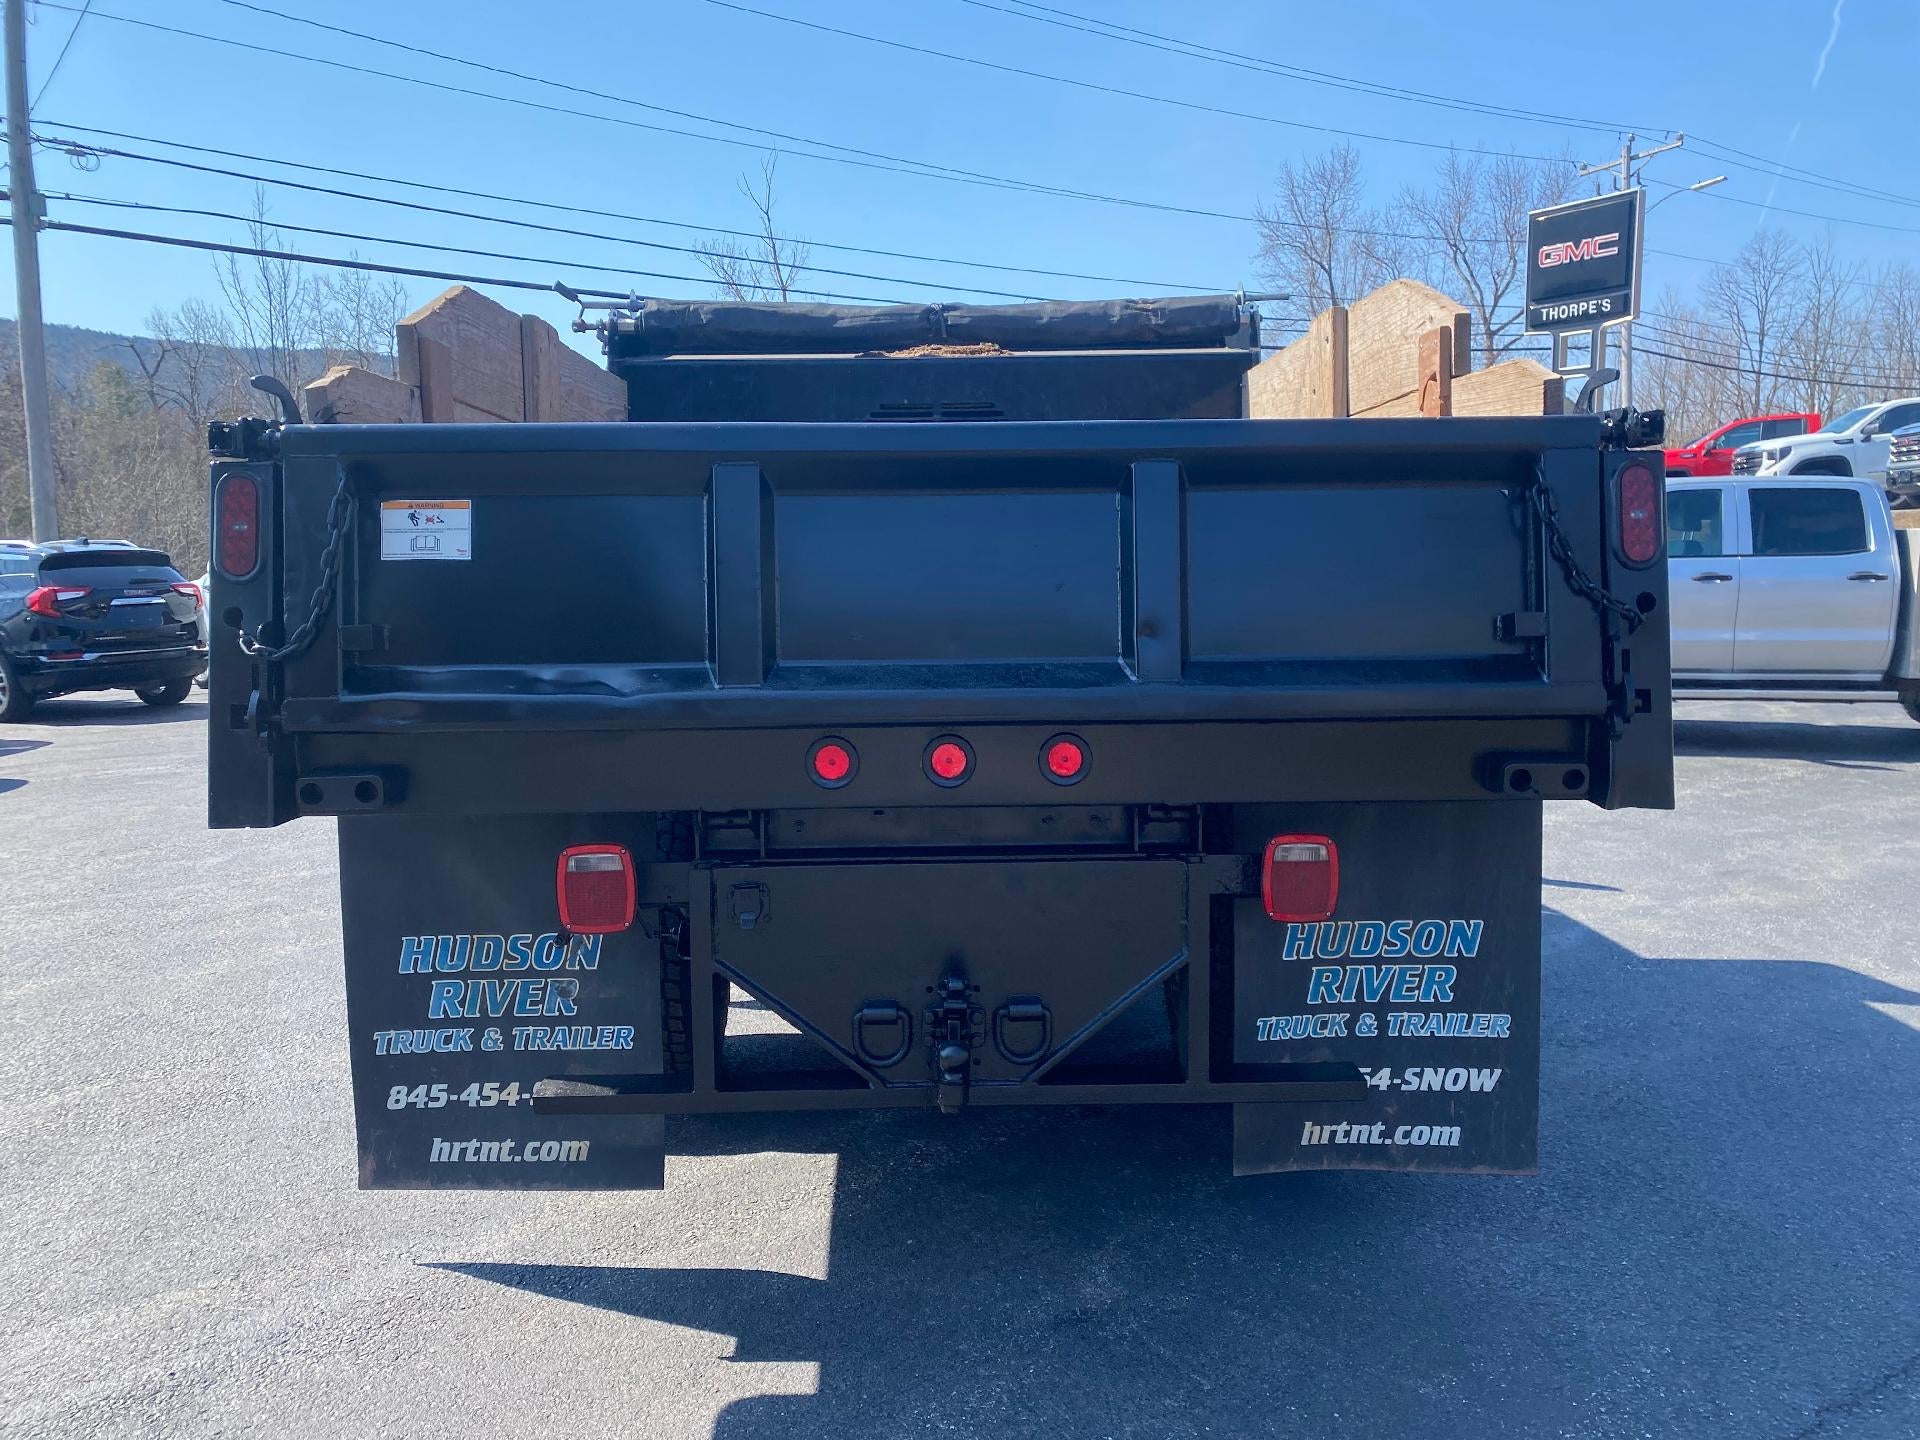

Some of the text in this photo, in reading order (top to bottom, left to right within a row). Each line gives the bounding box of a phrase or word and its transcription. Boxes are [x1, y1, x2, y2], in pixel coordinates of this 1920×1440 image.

[1539, 233, 1619, 268] GMC
[1541, 299, 1611, 321] THORPE'S
[399, 934, 602, 973] HUDSON
[1283, 921, 1483, 959] HUDSON
[428, 978, 580, 1019] RIVER
[1307, 965, 1457, 1004] RIVER
[373, 1025, 635, 1055] TRUCK & TRAILER
[1256, 1011, 1512, 1041] TRUCK & TRAILER
[429, 1137, 590, 1162] hrtnt.com
[1300, 1121, 1461, 1147] hrtnt.com
